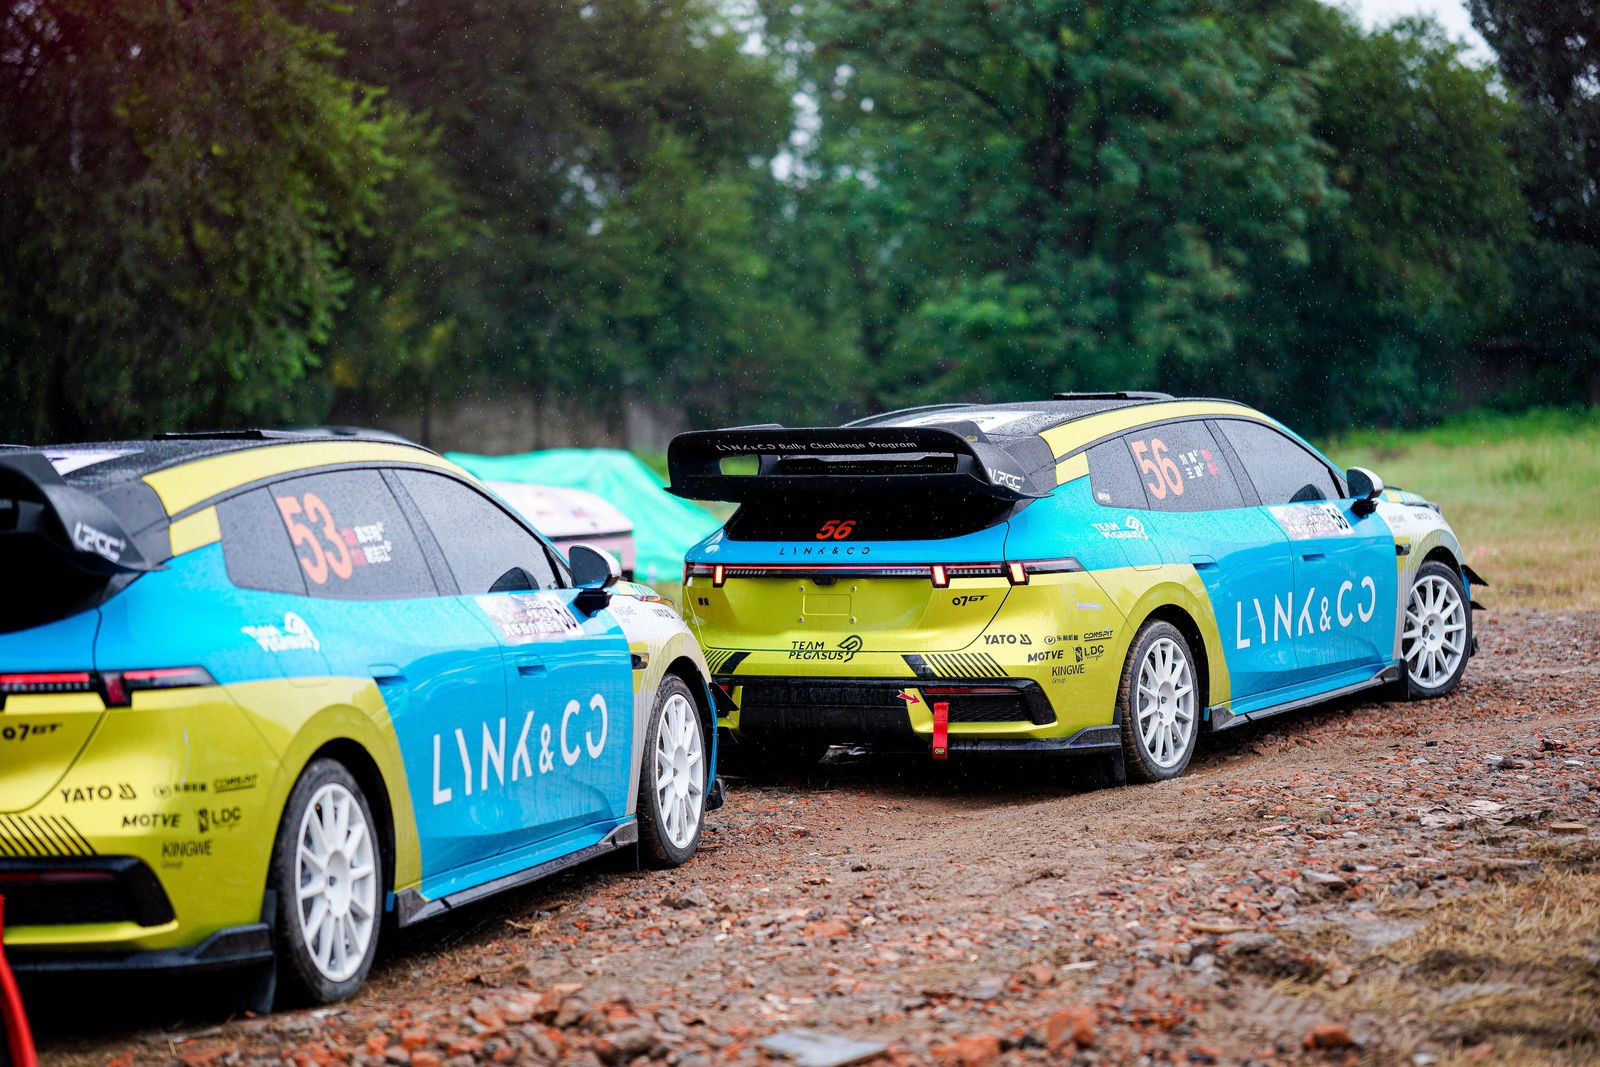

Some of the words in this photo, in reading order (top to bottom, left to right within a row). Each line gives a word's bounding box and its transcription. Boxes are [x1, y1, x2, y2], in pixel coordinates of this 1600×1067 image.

[778, 443, 806, 451] Rally
[809, 441, 865, 450] Challenge
[868, 440, 918, 449] Program
[1131, 438, 1184, 500] 56
[816, 519, 857, 540] 56
[275, 491, 353, 585] 53
[791, 640, 825, 650] TEAM
[983, 633, 1018, 645] YATO
[788, 651, 844, 661] PEGASUS
[1027, 649, 1064, 663] MOTVE
[1084, 644, 1105, 657] LDC
[1051, 663, 1085, 677] KINGWE
[61, 784, 112, 803] YATO
[121, 813, 181, 829] MOTVE
